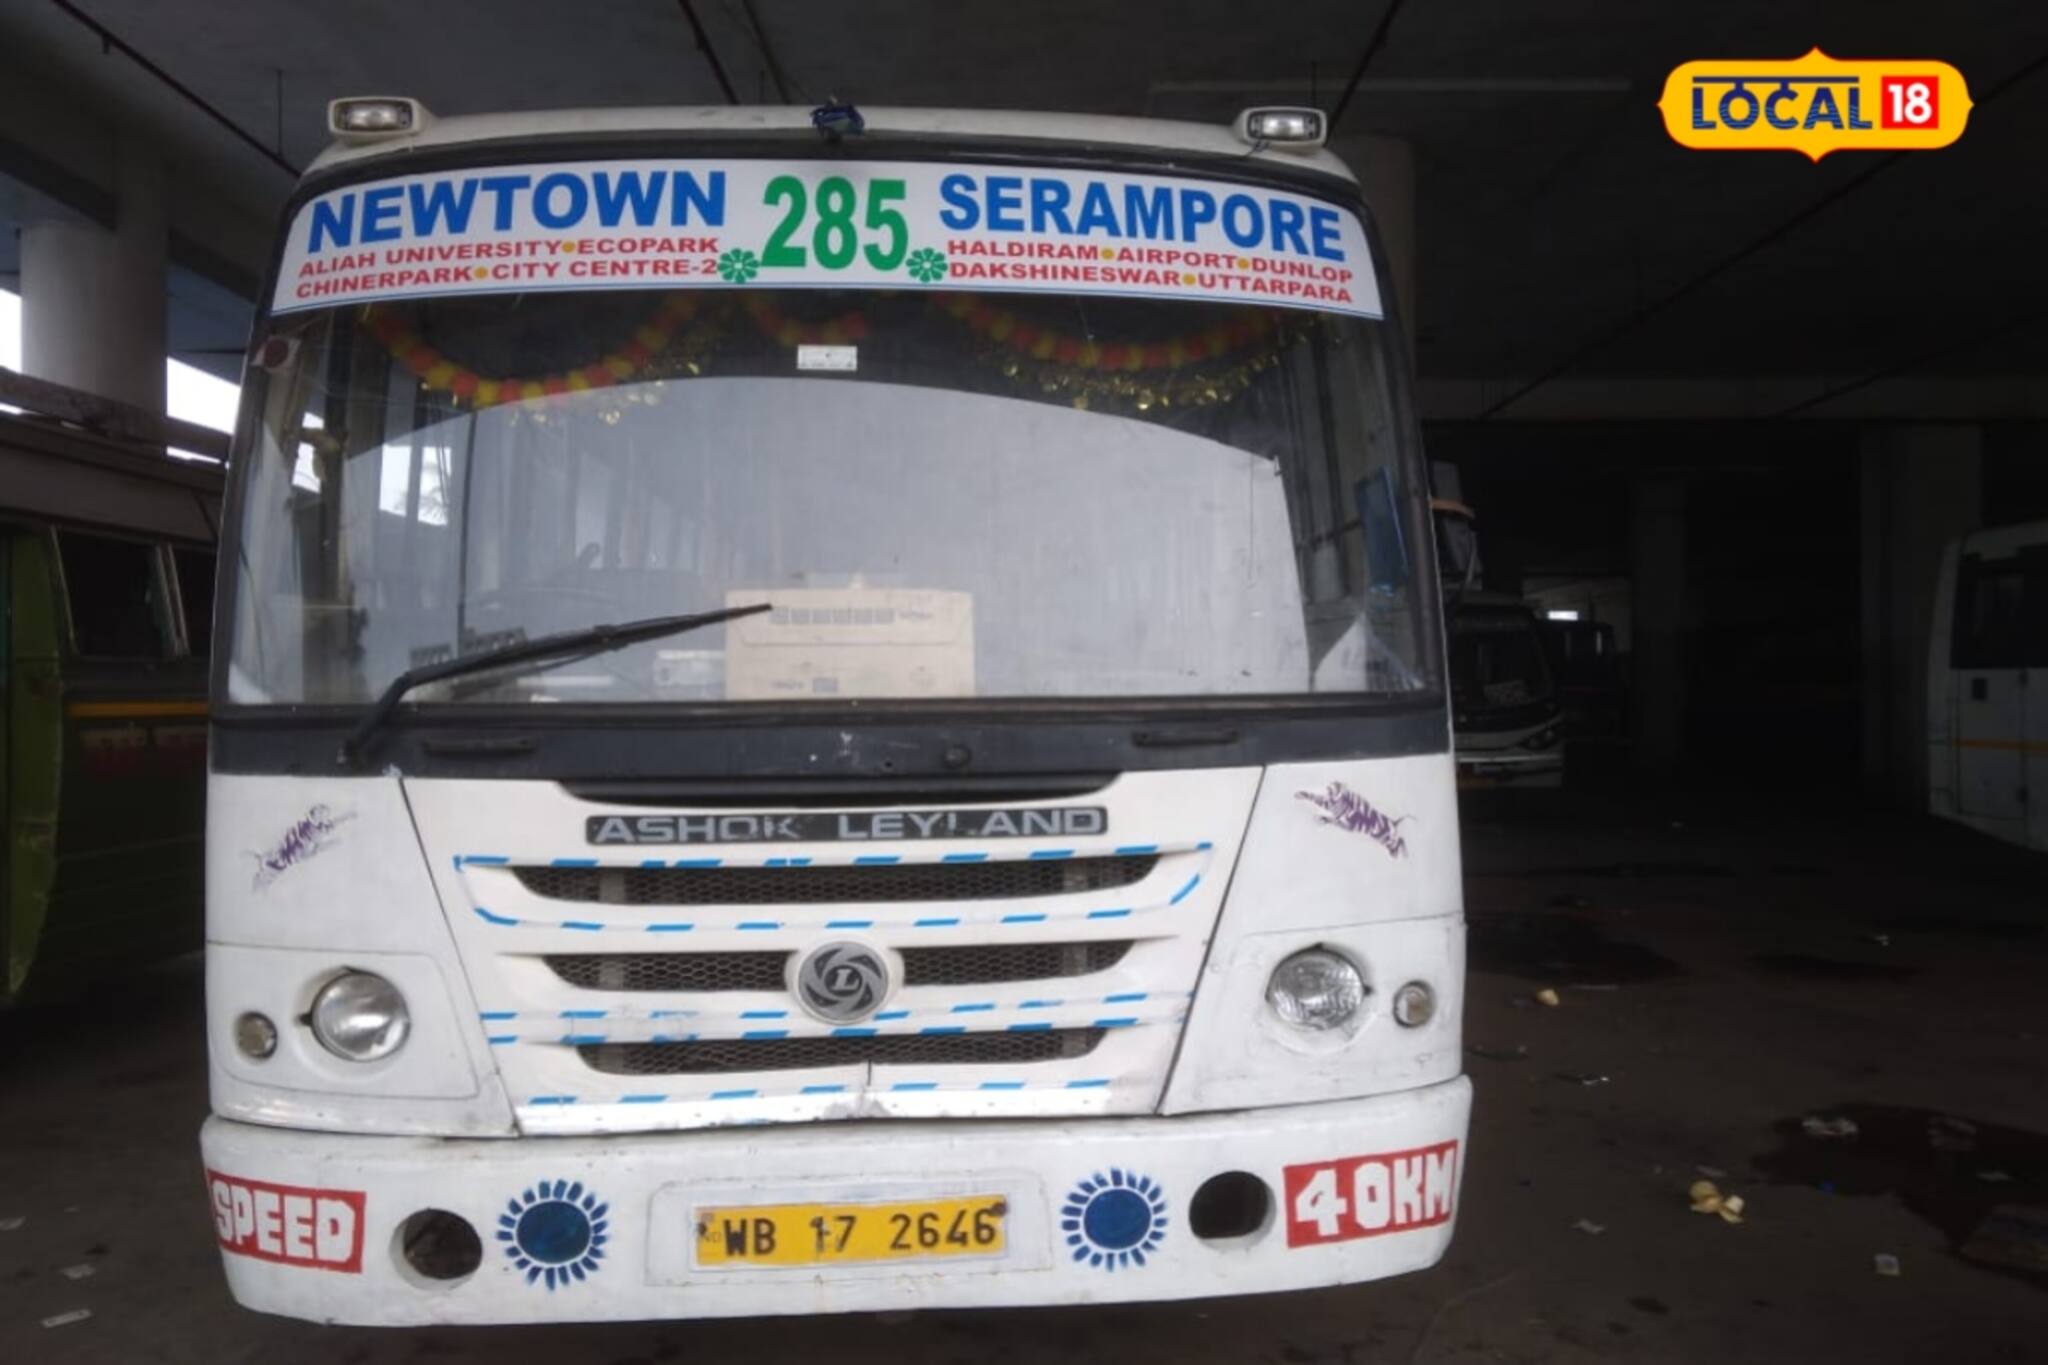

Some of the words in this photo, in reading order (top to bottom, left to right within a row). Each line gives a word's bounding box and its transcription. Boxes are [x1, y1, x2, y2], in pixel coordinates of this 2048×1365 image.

[308, 171, 725, 253] NEWTOWN
[761, 175, 908, 271] 285
[939, 174, 1346, 262] SERAMPORE
[297, 266, 471, 298] CHINERPARK
[492, 263, 561, 281] CITY
[569, 259, 717, 277] CENTRE-2
[299, 252, 376, 278] ALIAH
[385, 241, 561, 264] UNIVERSITY
[578, 237, 719, 255] ECOPARK
[948, 240, 1099, 261] HALDIRAM
[1117, 249, 1237, 271] AIRPORT
[1252, 257, 1353, 284] DUNLOP
[949, 261, 1180, 287] DAKSHINESWAR
[1199, 273, 1353, 304] UTTARPARA
[595, 815, 799, 843] ASHOK
[1295, 1148, 1455, 1236] 40KM
[212, 1180, 355, 1262] SPEED
[724, 1217, 776, 1256] WB
[810, 1215, 857, 1252] 17
[889, 1208, 996, 1250] 2646
